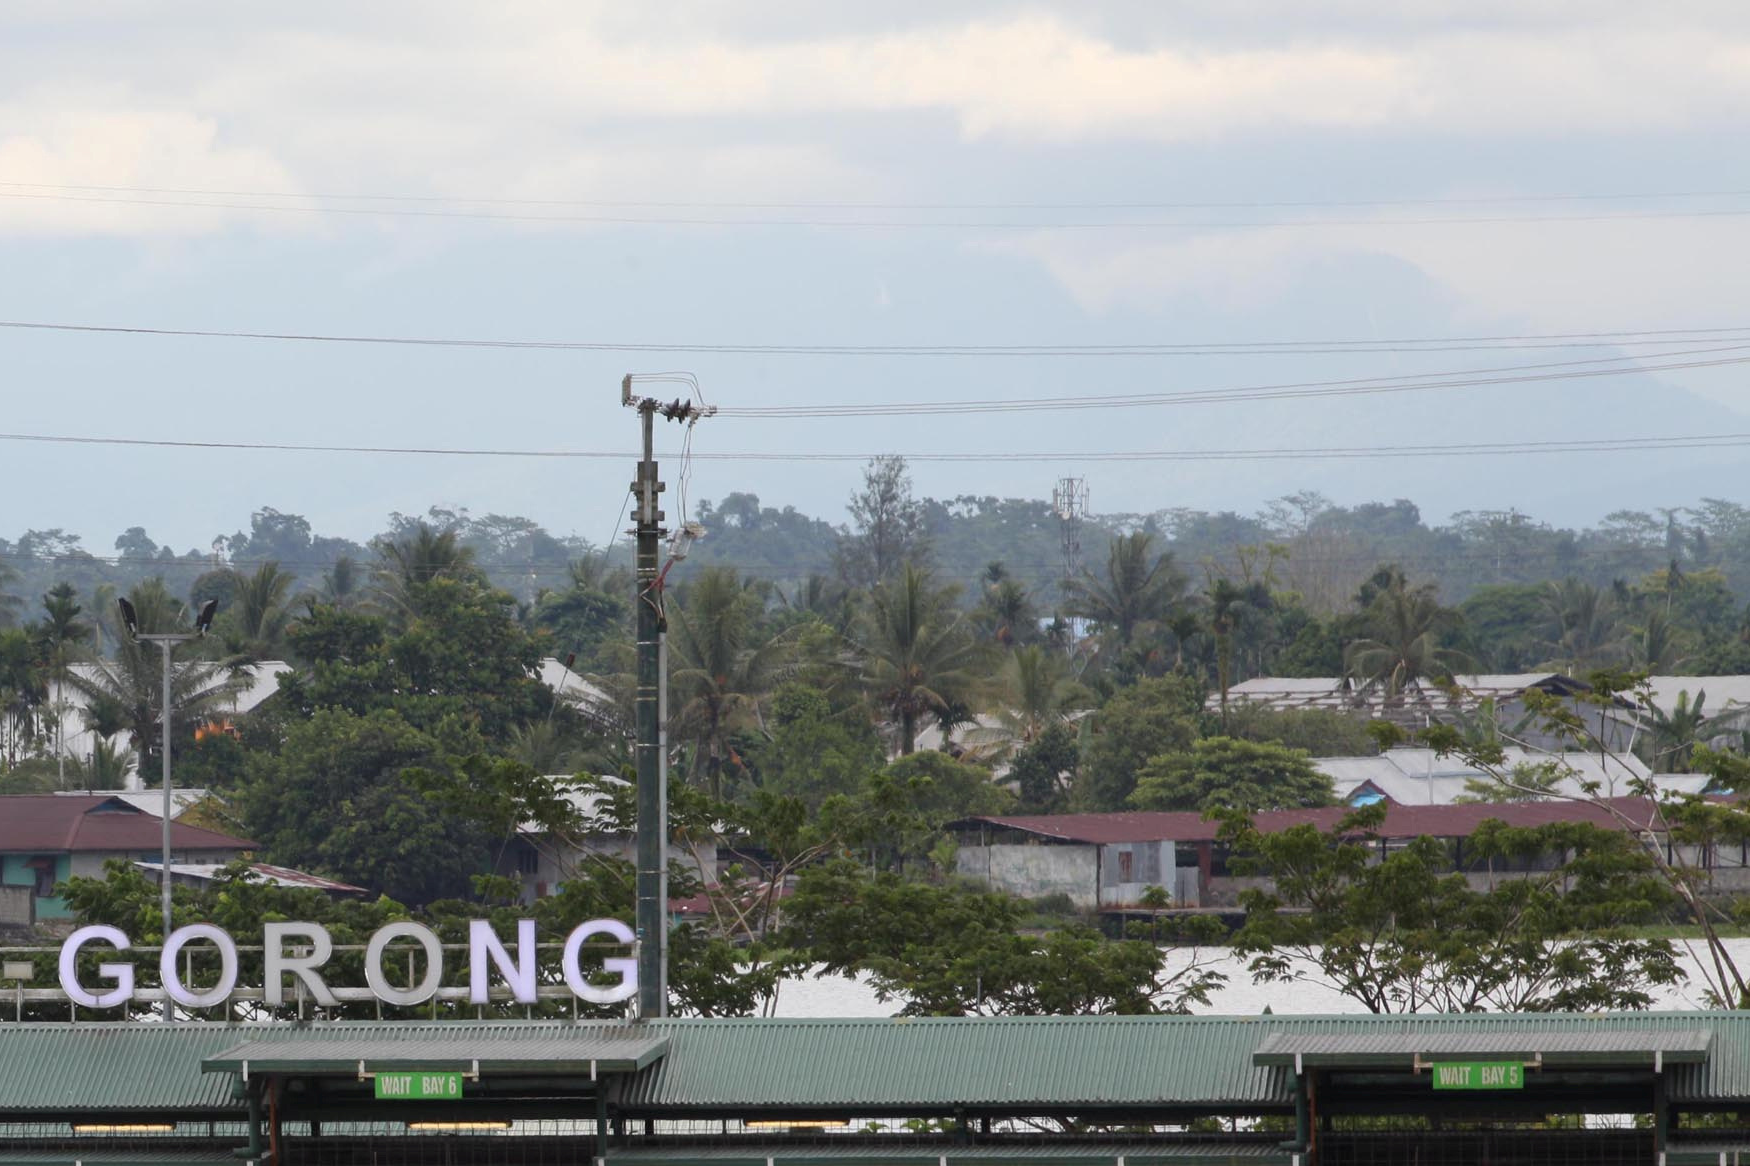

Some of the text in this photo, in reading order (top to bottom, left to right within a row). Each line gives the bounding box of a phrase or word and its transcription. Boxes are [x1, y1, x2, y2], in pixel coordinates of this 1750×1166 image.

[1440, 1065, 1518, 1085] WAIT BAY 5
[381, 1076, 457, 1095] WAIT BAY 6
